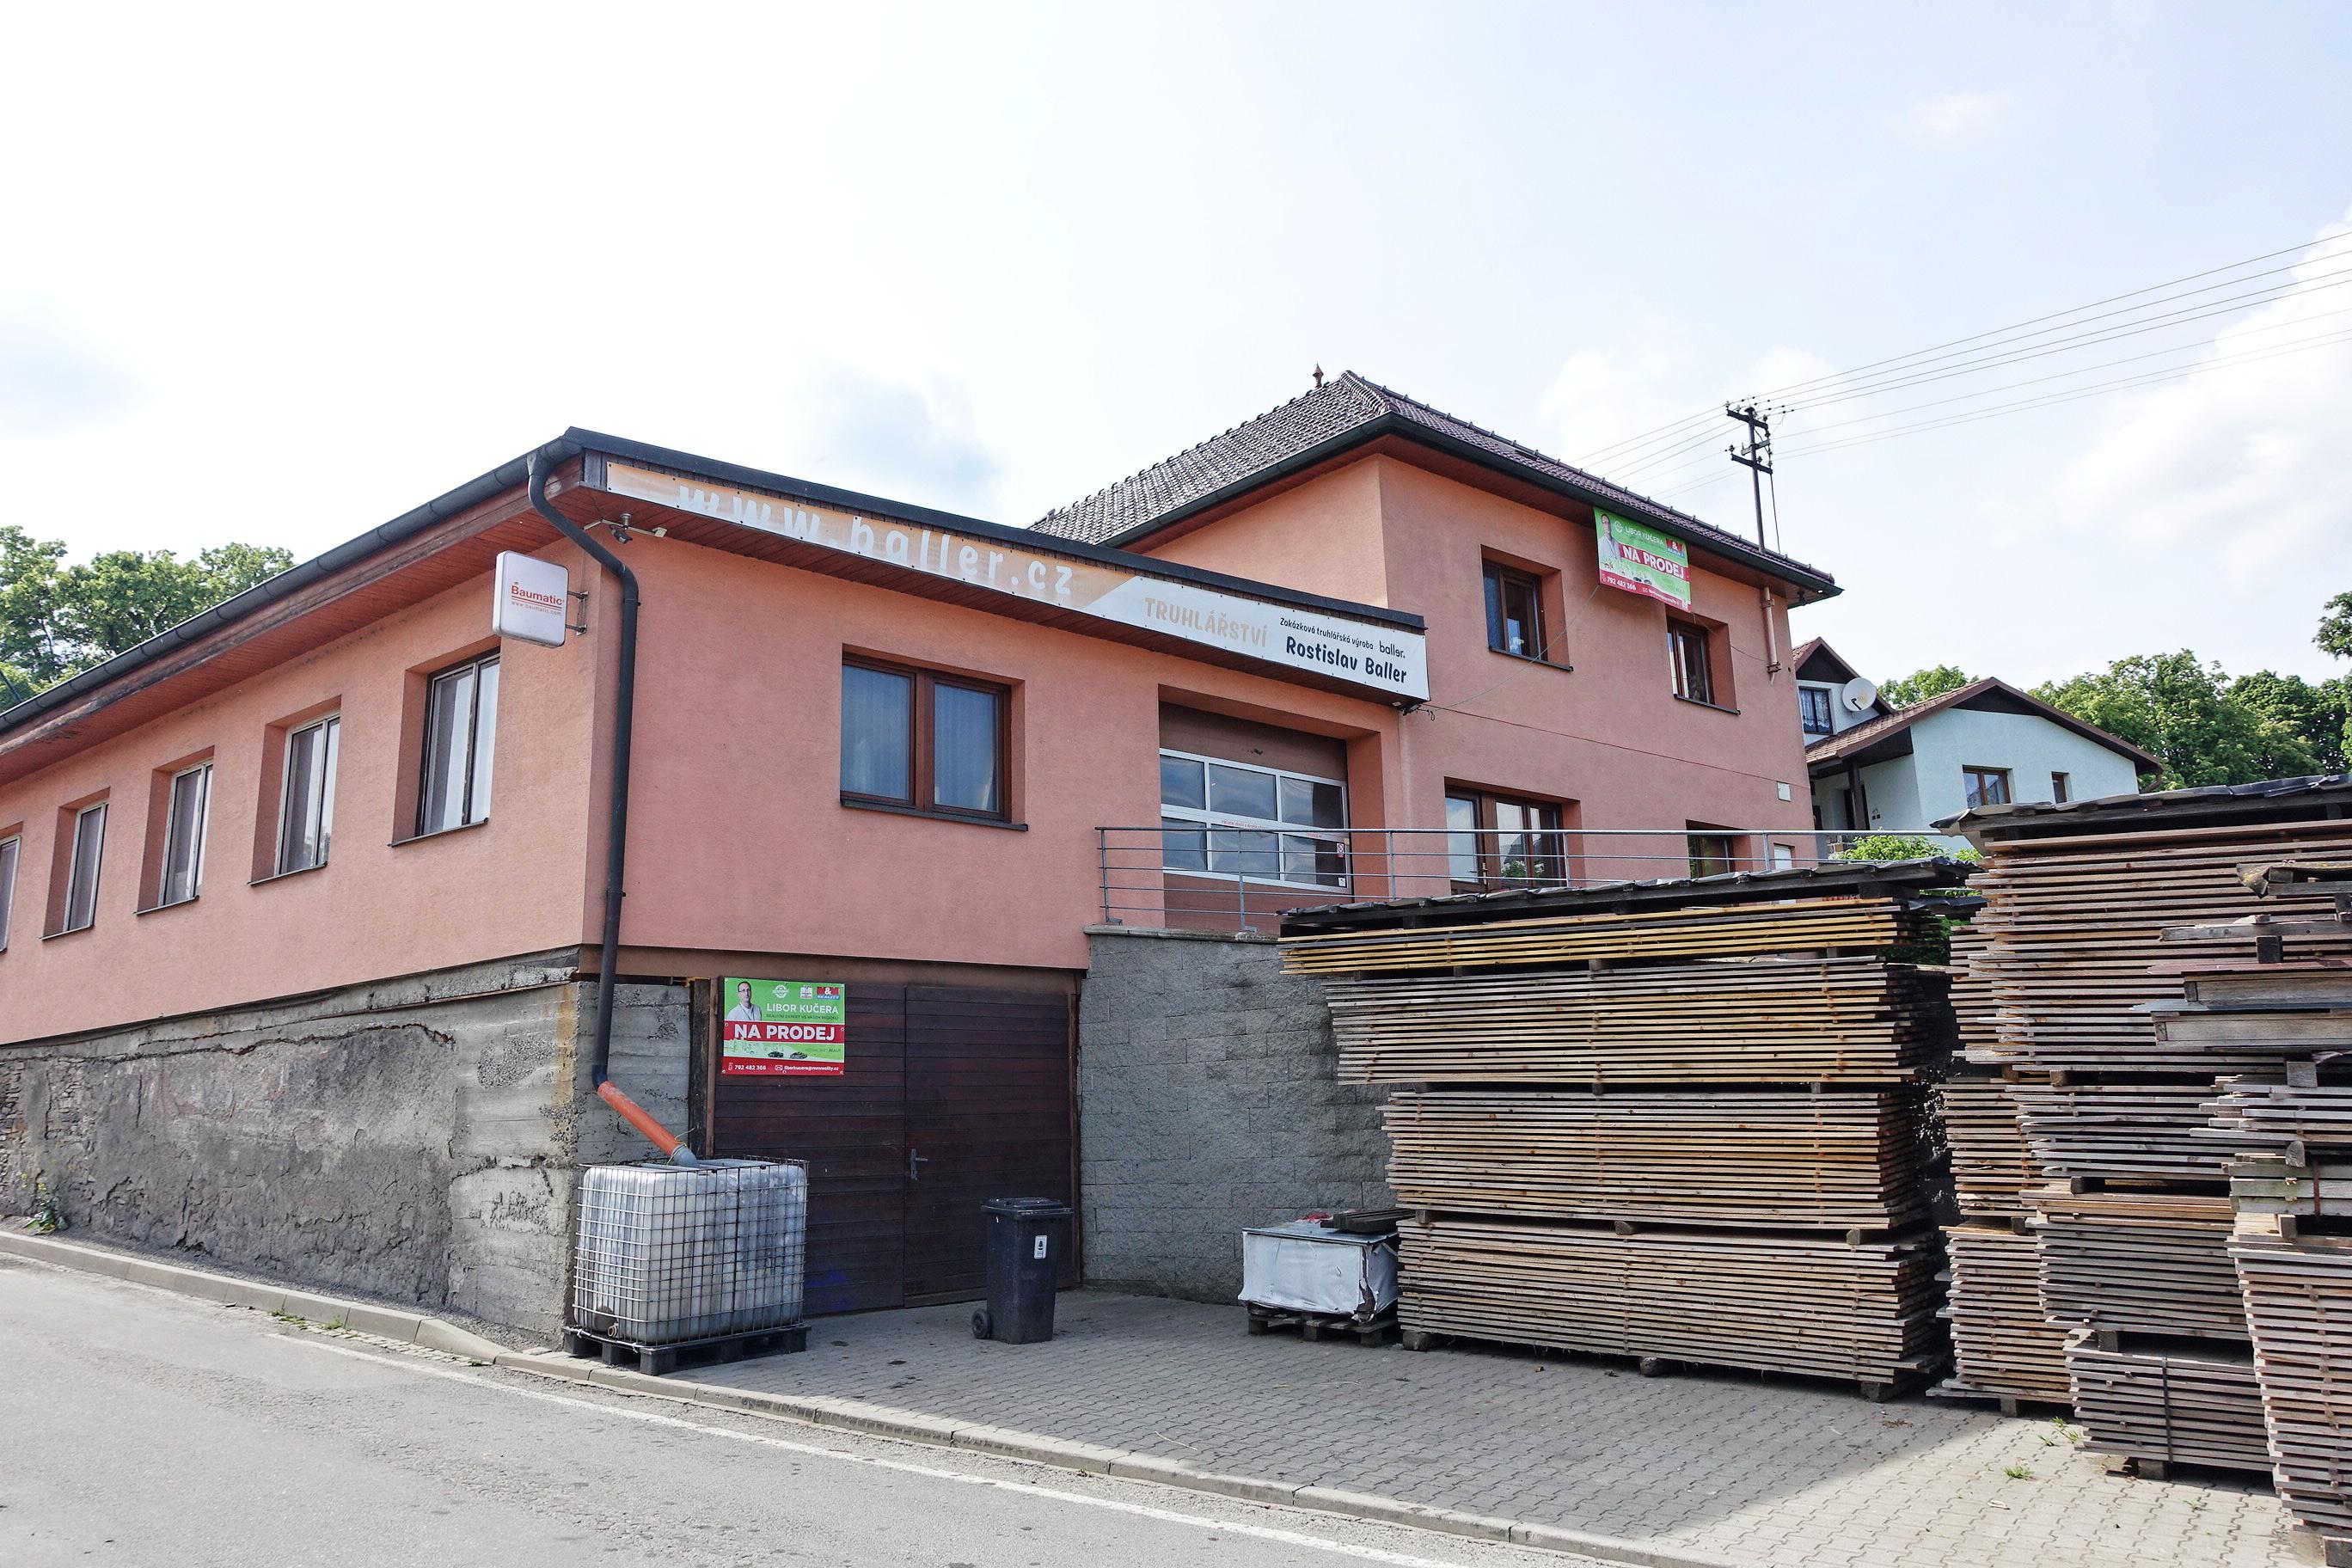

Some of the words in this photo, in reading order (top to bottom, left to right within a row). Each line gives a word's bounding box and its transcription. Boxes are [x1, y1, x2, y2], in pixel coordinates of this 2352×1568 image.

[1622, 545, 1640, 563] NA
[1644, 553, 1685, 579] PRODEJ
[511, 585, 562, 605] Baumatic
[511, 602, 562, 615] www.baumatic.com
[1144, 597, 1268, 647] TRUHLÁŘSTVÍ
[1279, 617, 1315, 634] Zakázková
[1316, 628, 1351, 643] truhlářská
[1352, 638, 1374, 650] výroba
[1286, 635, 1358, 671] Rostislav
[1365, 657, 1406, 683] Baller
[767, 1003, 796, 1012] LIBOR
[799, 1003, 839, 1014] KUČERA
[734, 1024, 761, 1038] NA
[766, 1025, 835, 1041] PRODEJ
